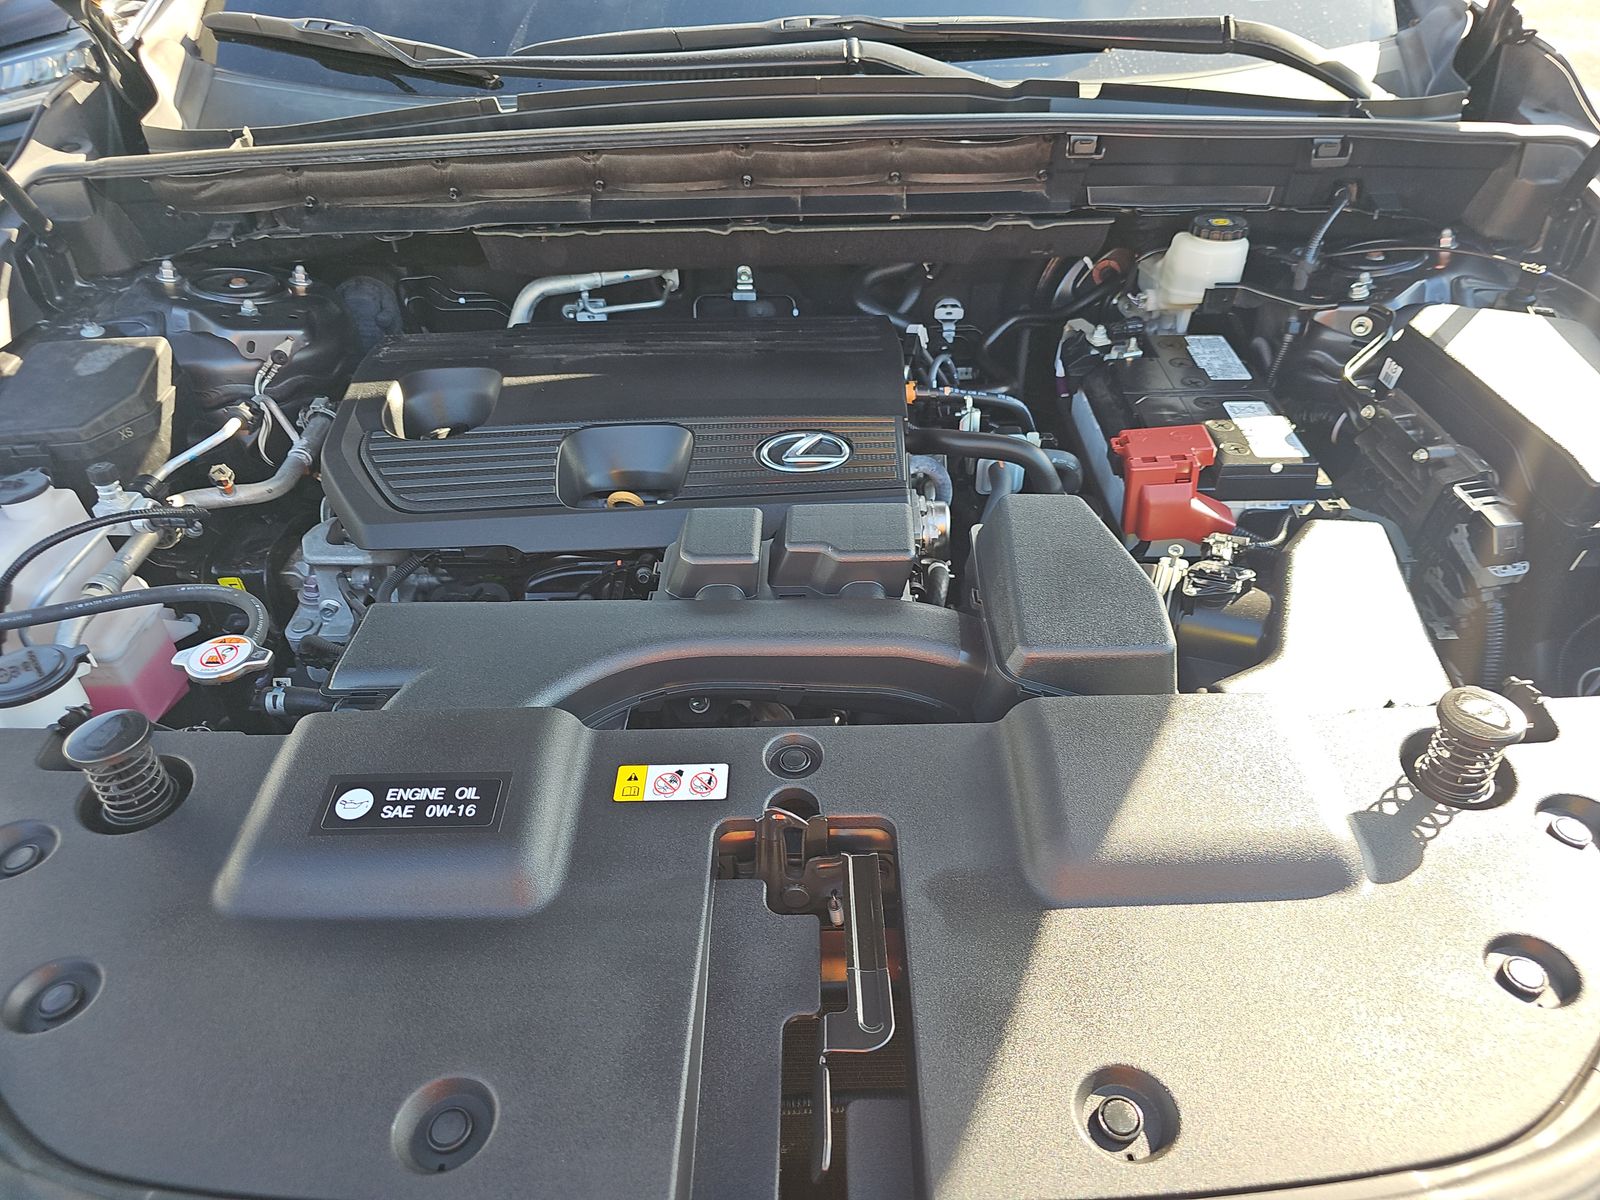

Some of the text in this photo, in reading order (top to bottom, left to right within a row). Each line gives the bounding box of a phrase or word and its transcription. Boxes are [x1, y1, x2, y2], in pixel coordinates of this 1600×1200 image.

[386, 786, 481, 801] ENGINE OIL
[380, 803, 477, 819] SAE 0W-16
